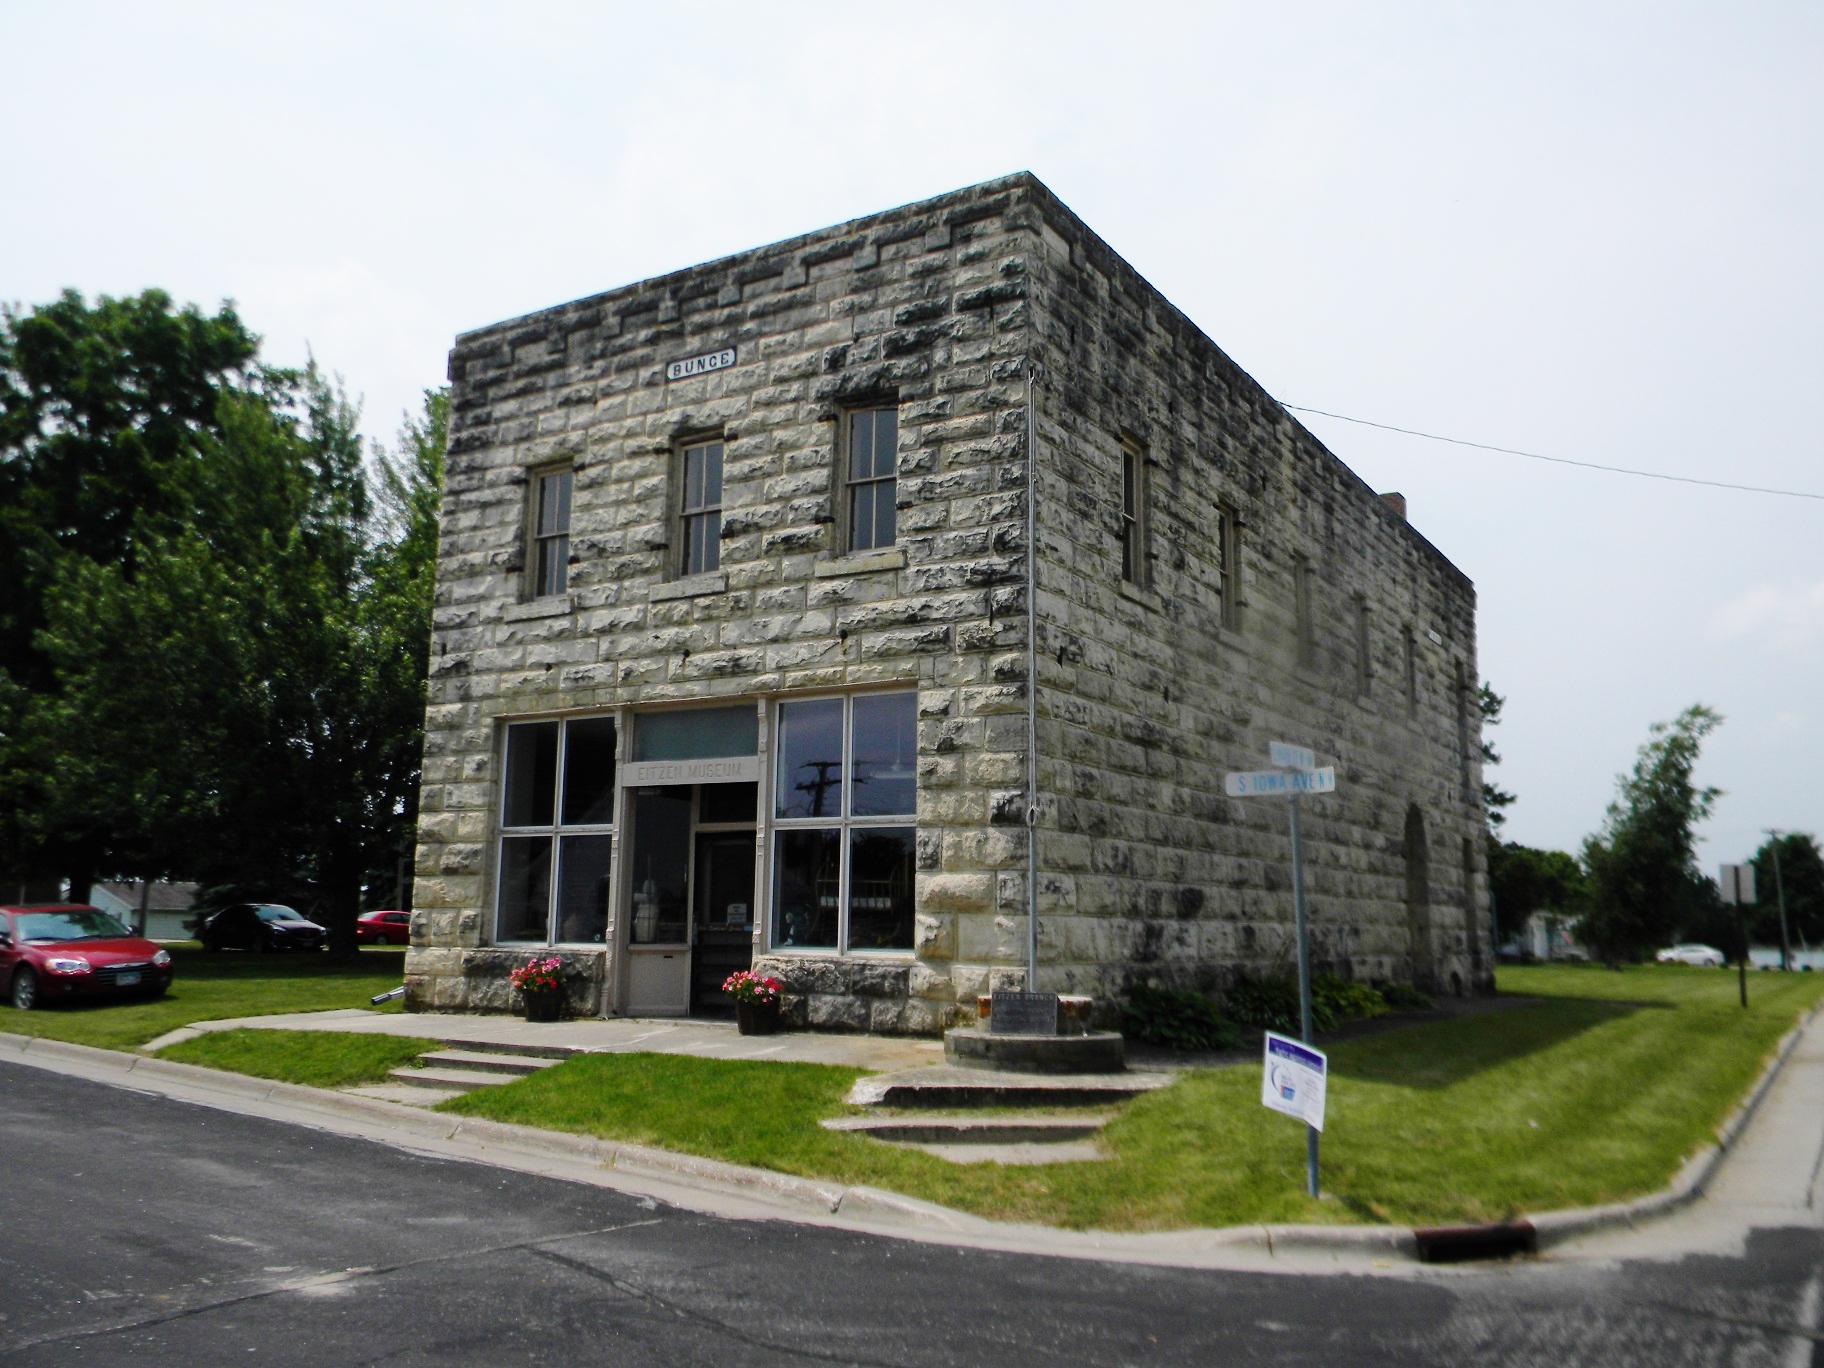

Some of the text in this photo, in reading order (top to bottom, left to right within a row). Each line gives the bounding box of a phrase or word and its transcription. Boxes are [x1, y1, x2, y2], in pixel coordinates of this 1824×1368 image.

[639, 762, 741, 781] EITZEN MUSEUM
[1238, 774, 1246, 793] S
[1252, 774, 1287, 792] IOWA
[1292, 772, 1313, 790] AVE
